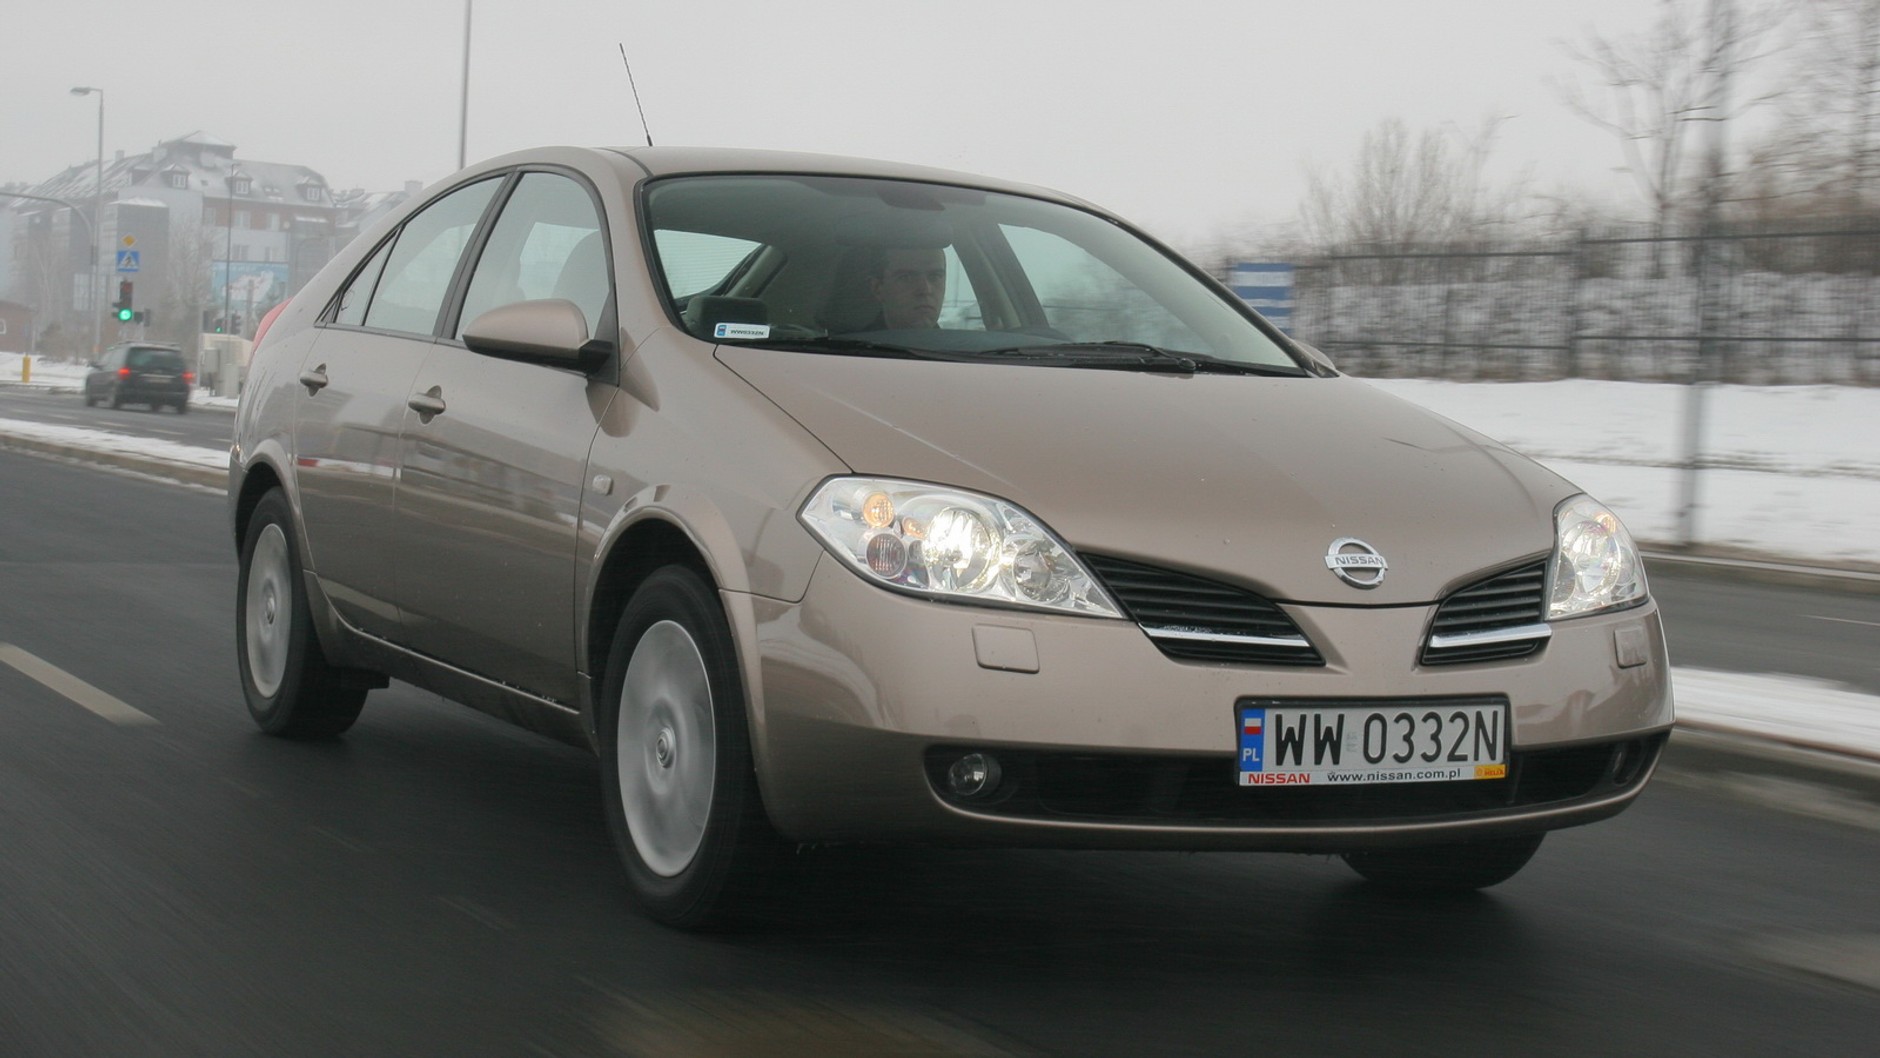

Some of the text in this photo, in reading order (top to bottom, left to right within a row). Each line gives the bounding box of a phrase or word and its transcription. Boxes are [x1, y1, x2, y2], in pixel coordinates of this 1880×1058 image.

[1335, 556, 1383, 566] NISSAN
[1275, 710, 1499, 766] WW 0332N
[1242, 748, 1260, 762] PL
[1248, 768, 1461, 784] NISSAN www.nissan.com.pl
